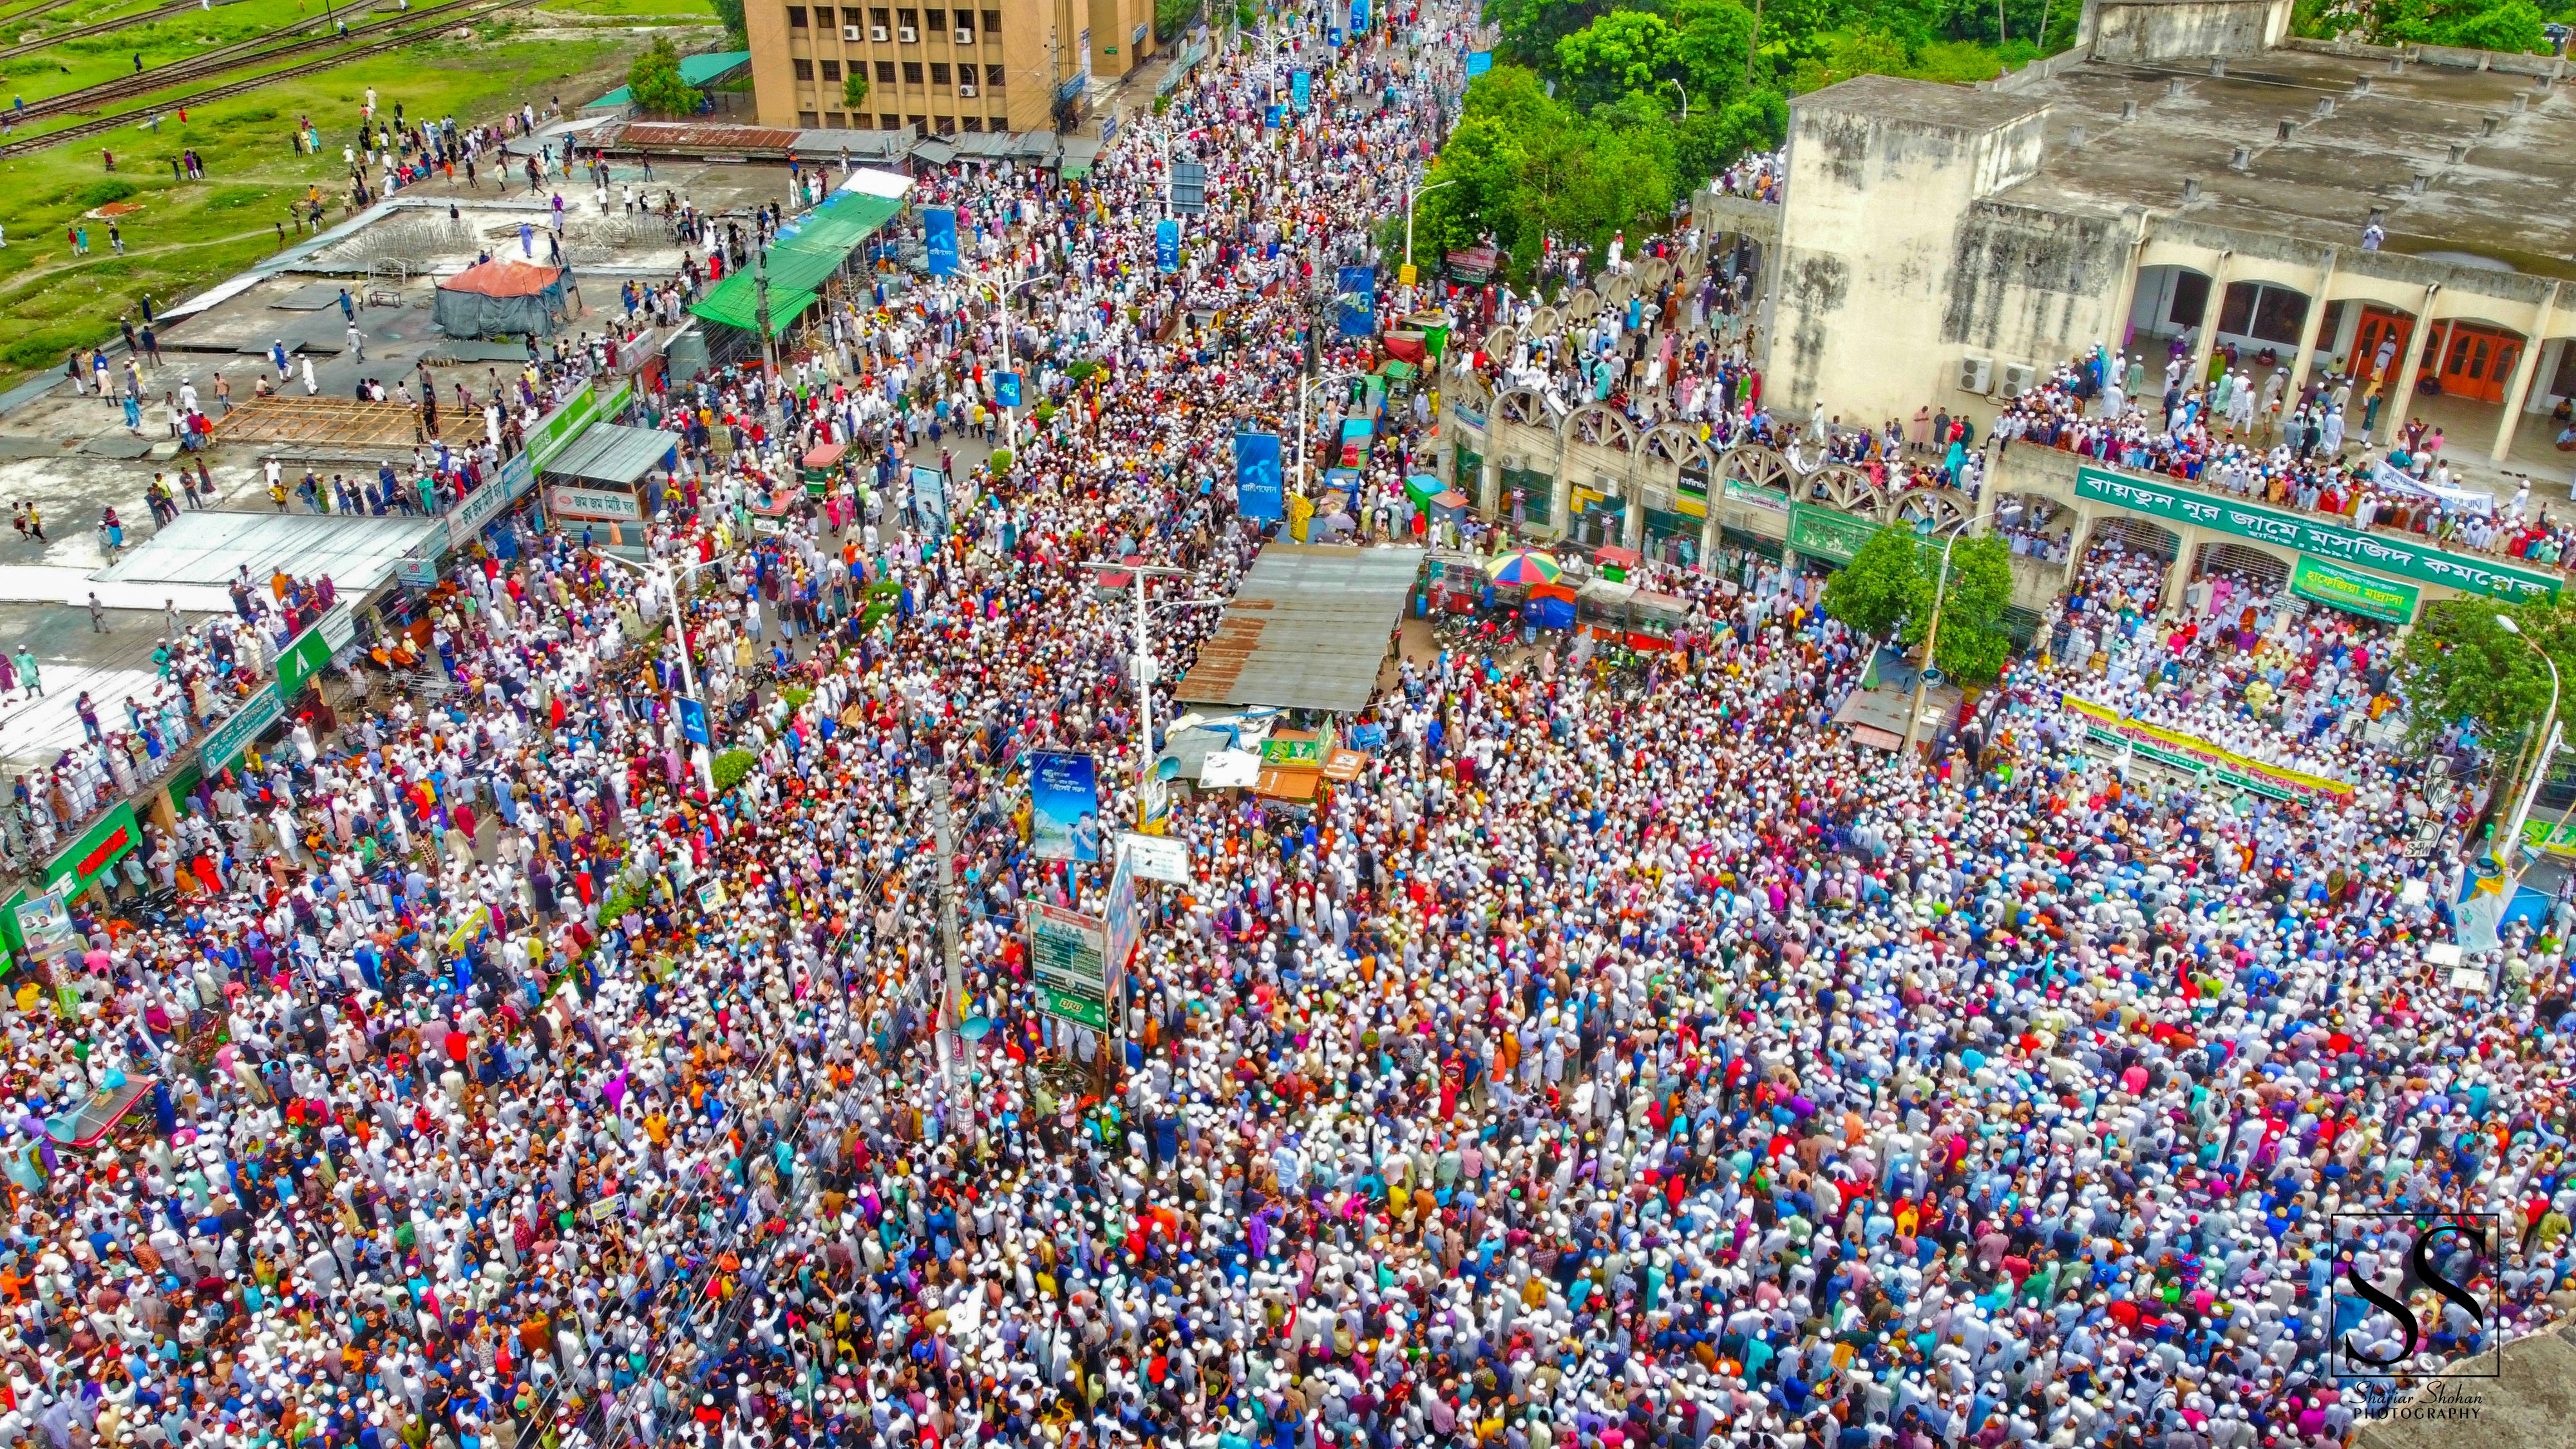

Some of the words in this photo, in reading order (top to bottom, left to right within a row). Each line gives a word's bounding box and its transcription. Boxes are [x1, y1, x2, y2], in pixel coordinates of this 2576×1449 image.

[1344, 292, 1369, 308] 4G
[1000, 383, 1015, 393] 4G
[1680, 475, 1707, 489] Infinix
[573, 495, 588, 510] জম
[588, 497, 603, 511] জম
[604, 495, 621, 512] মিষ্টি
[622, 501, 635, 514] ঘর
[2085, 476, 2175, 510] বায়তুন
[2180, 498, 2222, 522] নূর
[2228, 509, 2300, 539] জামে
[2307, 528, 2415, 567] মসজিদ
[2306, 569, 2361, 596] হাফেজিয়া
[2364, 587, 2405, 607] মাদ্রাসা
[2116, 724, 2181, 753] প্রতিবাদ
[2416, 820, 2439, 842] D
[1059, 998, 1084, 1013] BRB
[952, 1035, 960, 1057] DMC
